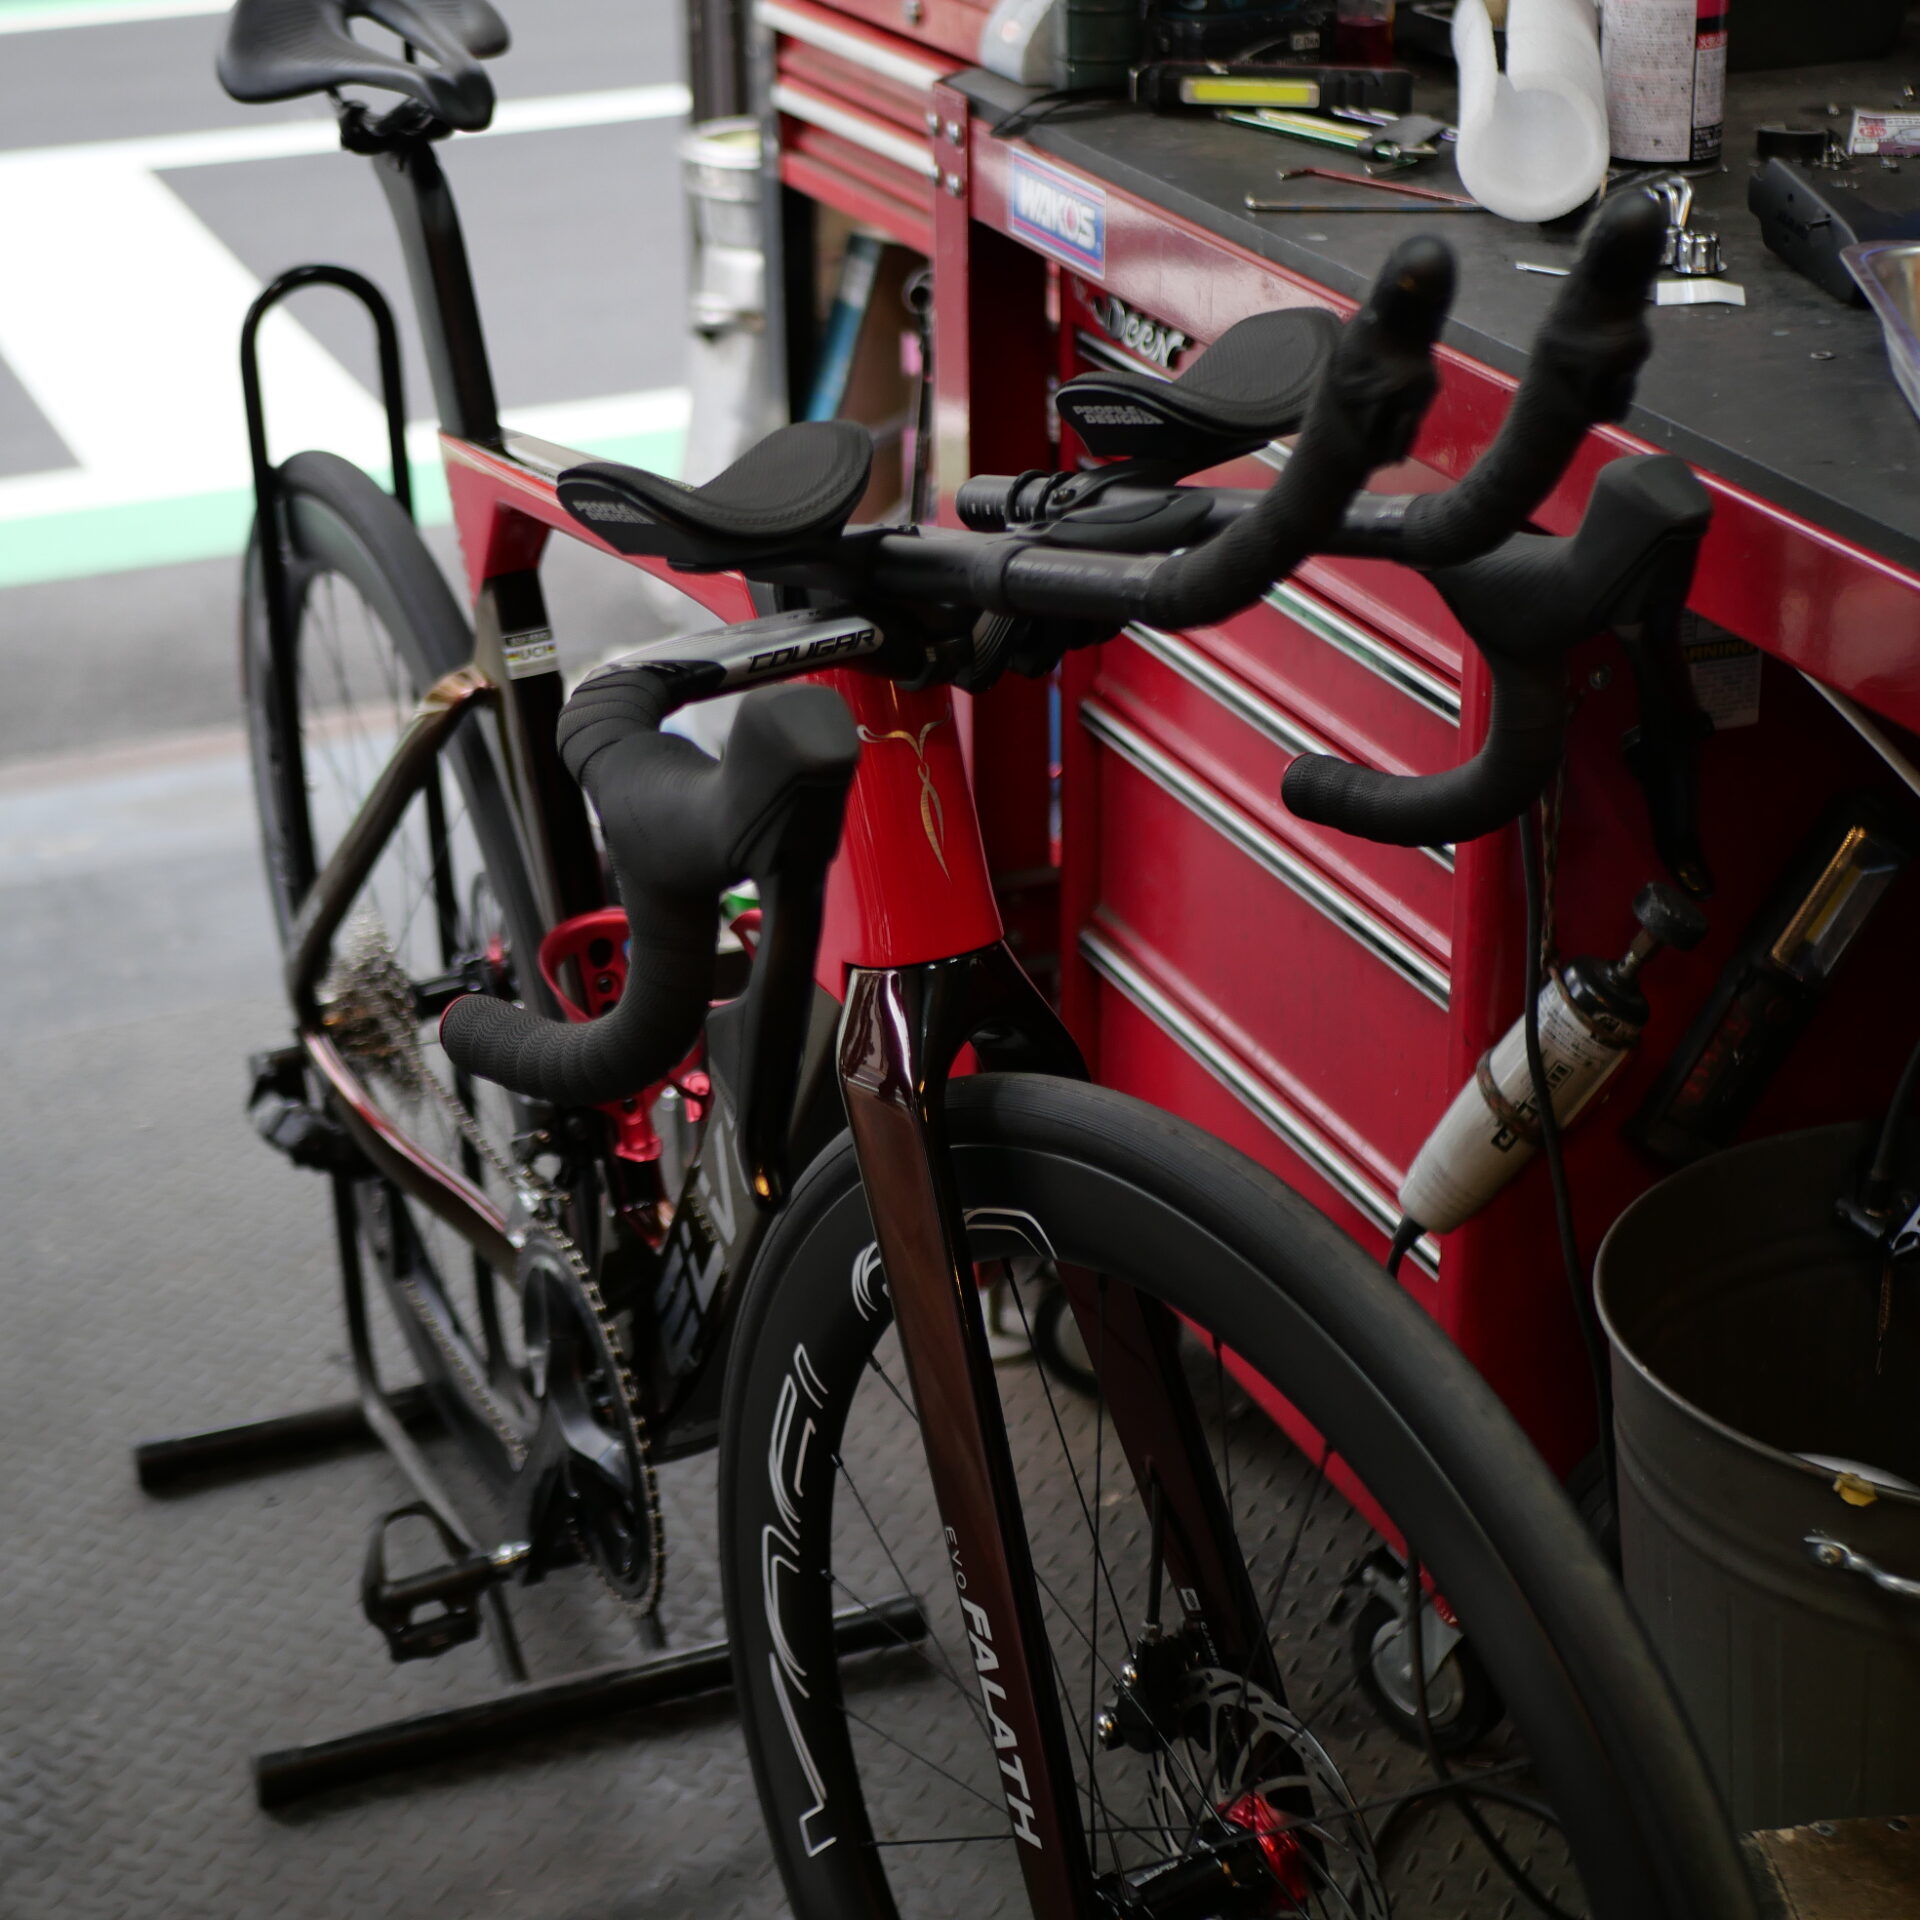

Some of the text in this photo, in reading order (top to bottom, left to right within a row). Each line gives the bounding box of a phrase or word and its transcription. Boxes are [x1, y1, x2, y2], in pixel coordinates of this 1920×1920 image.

[748, 628, 876, 674] COUGAR
[944, 1526, 1043, 1850] EVO FALATH
